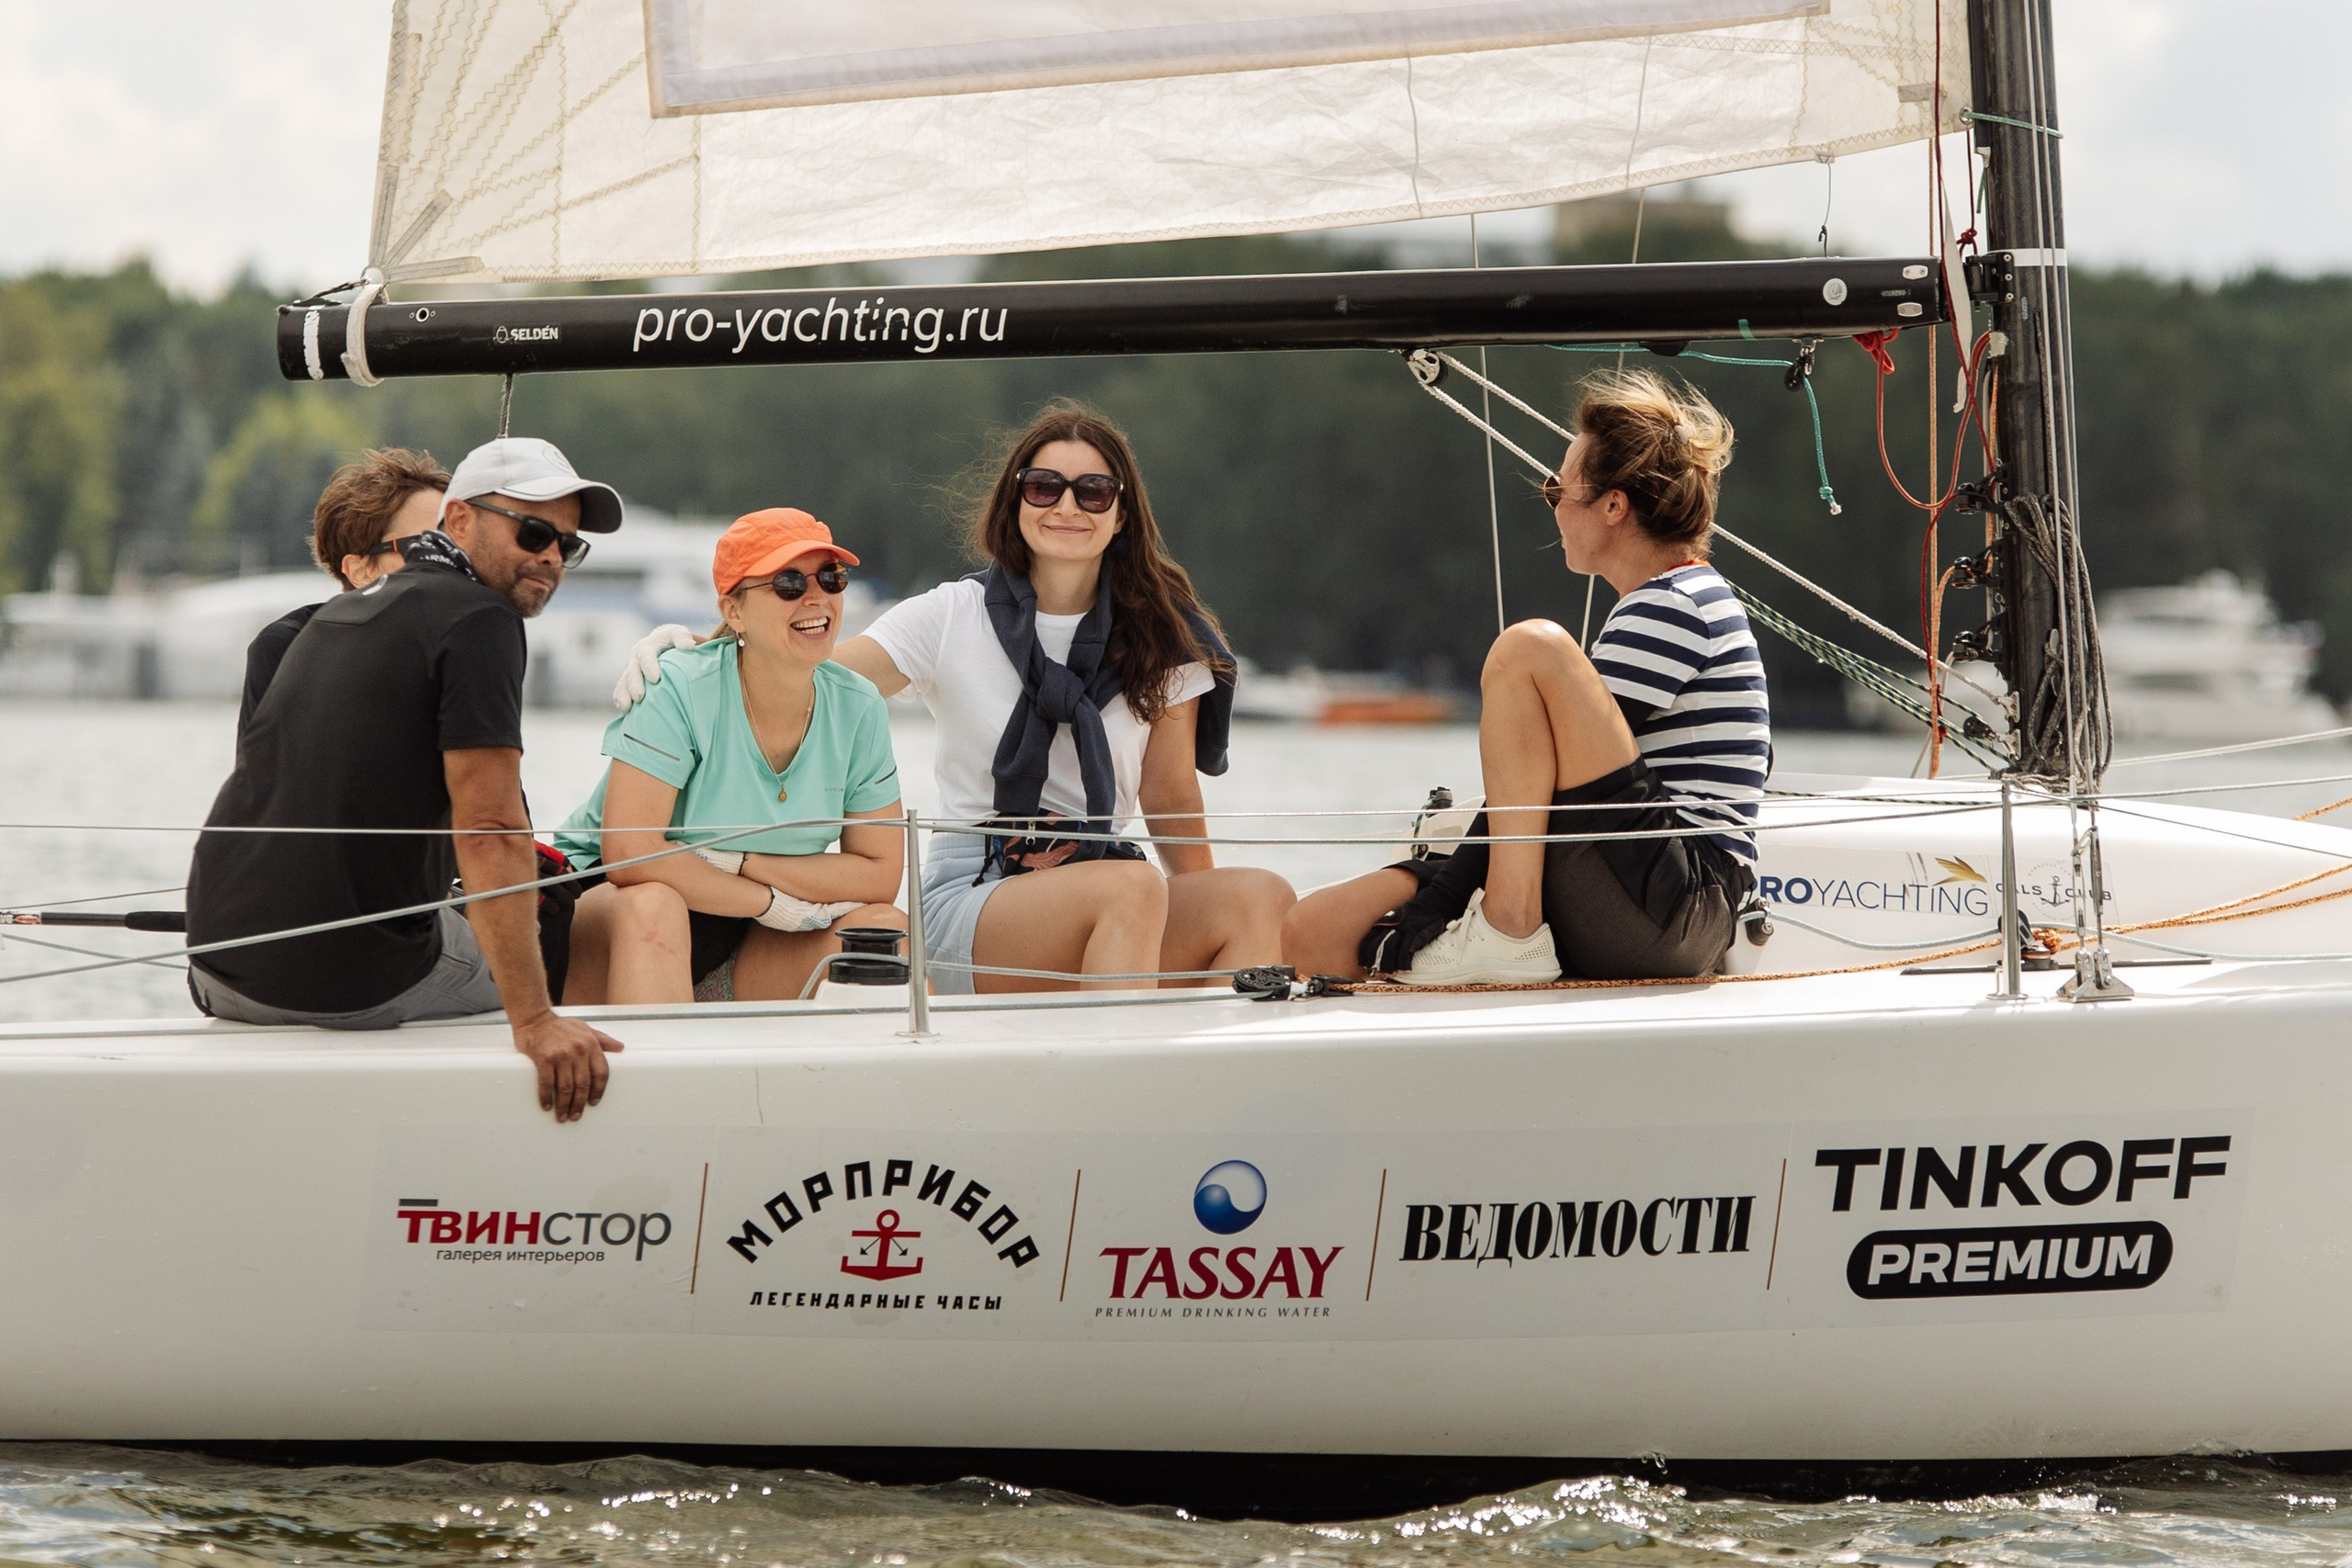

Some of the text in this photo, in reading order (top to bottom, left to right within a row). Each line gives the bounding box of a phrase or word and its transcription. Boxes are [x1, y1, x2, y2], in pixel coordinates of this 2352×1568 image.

[510, 324, 559, 341] SELDÉN
[632, 297, 1008, 354] pro-yachting.ru
[1744, 874, 1988, 916] ROYACHTING
[1815, 1135, 2232, 1213] TINKOFF
[726, 1159, 1040, 1269] МОРПРИБОР
[1398, 1195, 1757, 1269] ВЕДОМОСТИ
[435, 1247, 605, 1266] галерея интерьеров
[1098, 1246, 1345, 1301] TASSAY
[1867, 1235, 2154, 1285] PREMIUM
[749, 1291, 1003, 1311] ЛЕГЕНДАРНЫЕ ЧАСЫ
[1094, 1306, 1331, 1318] PREMIUM DRINKING WATER
